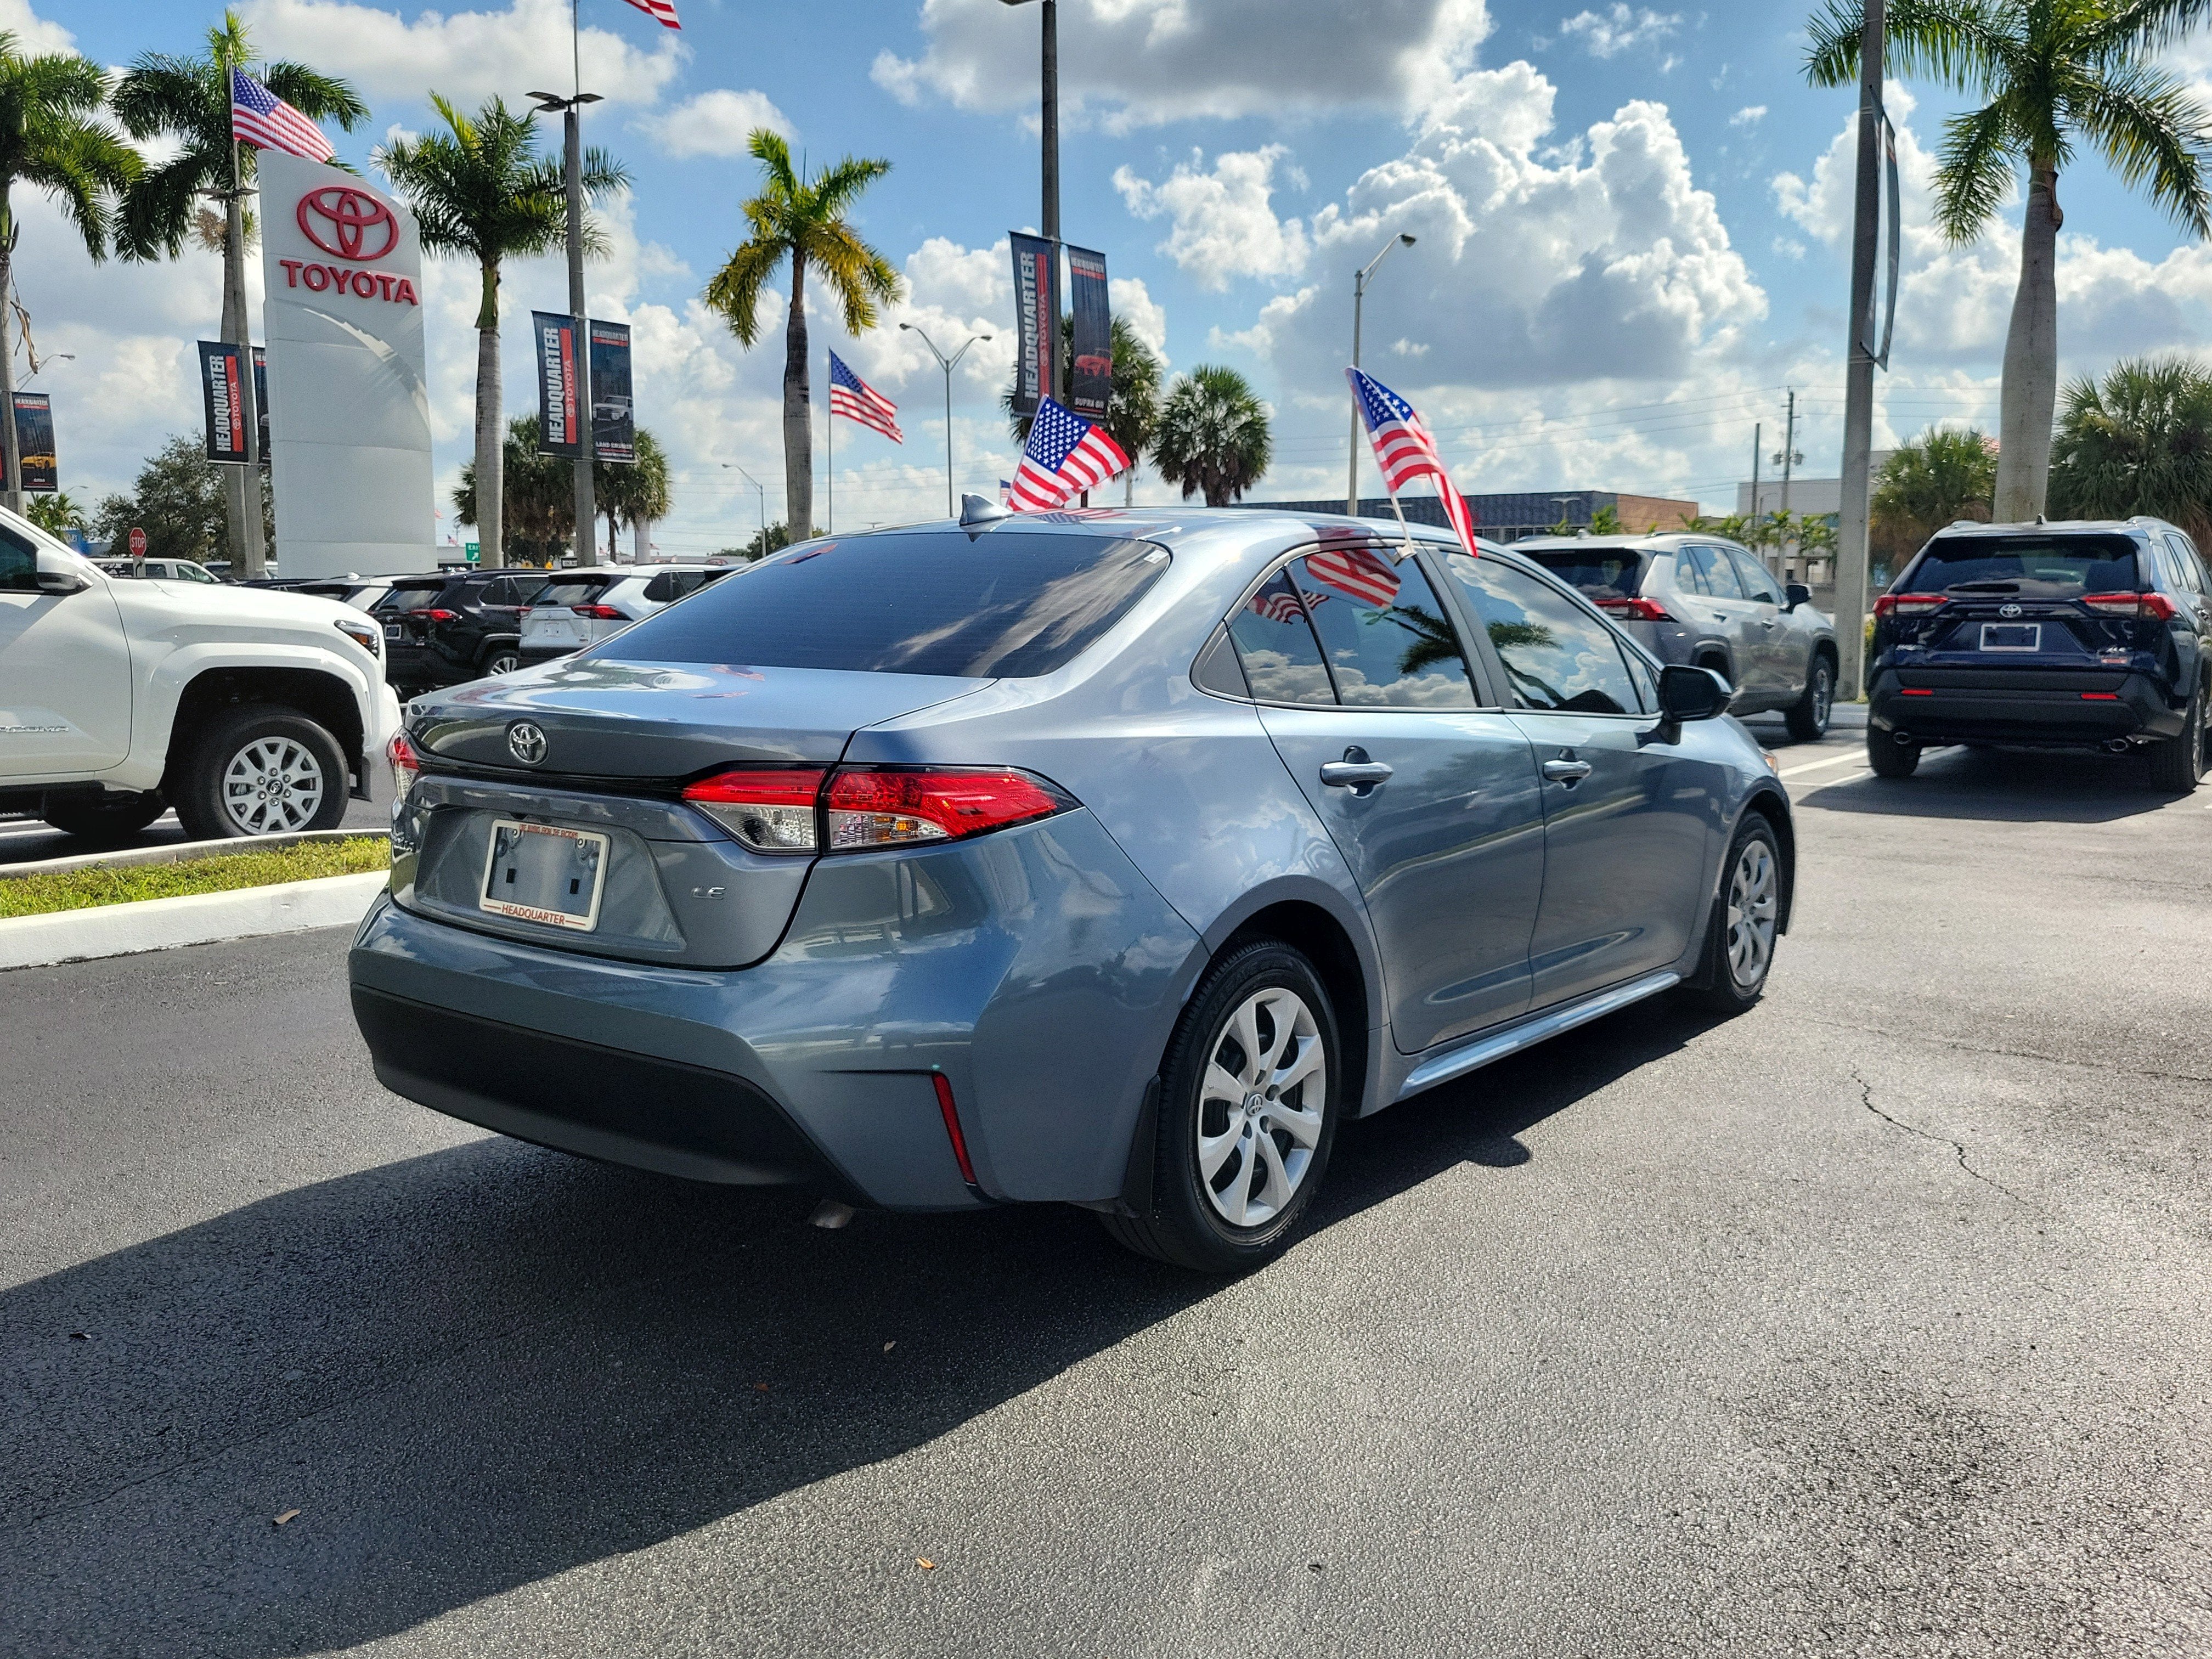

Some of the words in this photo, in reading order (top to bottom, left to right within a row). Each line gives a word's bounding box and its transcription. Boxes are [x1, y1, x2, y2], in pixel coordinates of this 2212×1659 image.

[280, 259, 419, 306] TOYOTA
[1020, 252, 1039, 399] HEADQUARTER
[1038, 295, 1048, 348] TOYOTA
[209, 356, 232, 452] HEADQUARTER
[230, 382, 240, 417] TOYOTA
[544, 328, 565, 443] HEADQUARTER
[564, 359, 574, 402] TOYOTA
[131, 537, 145, 548] STOP
[501, 904, 565, 925] HEADQUARTER
